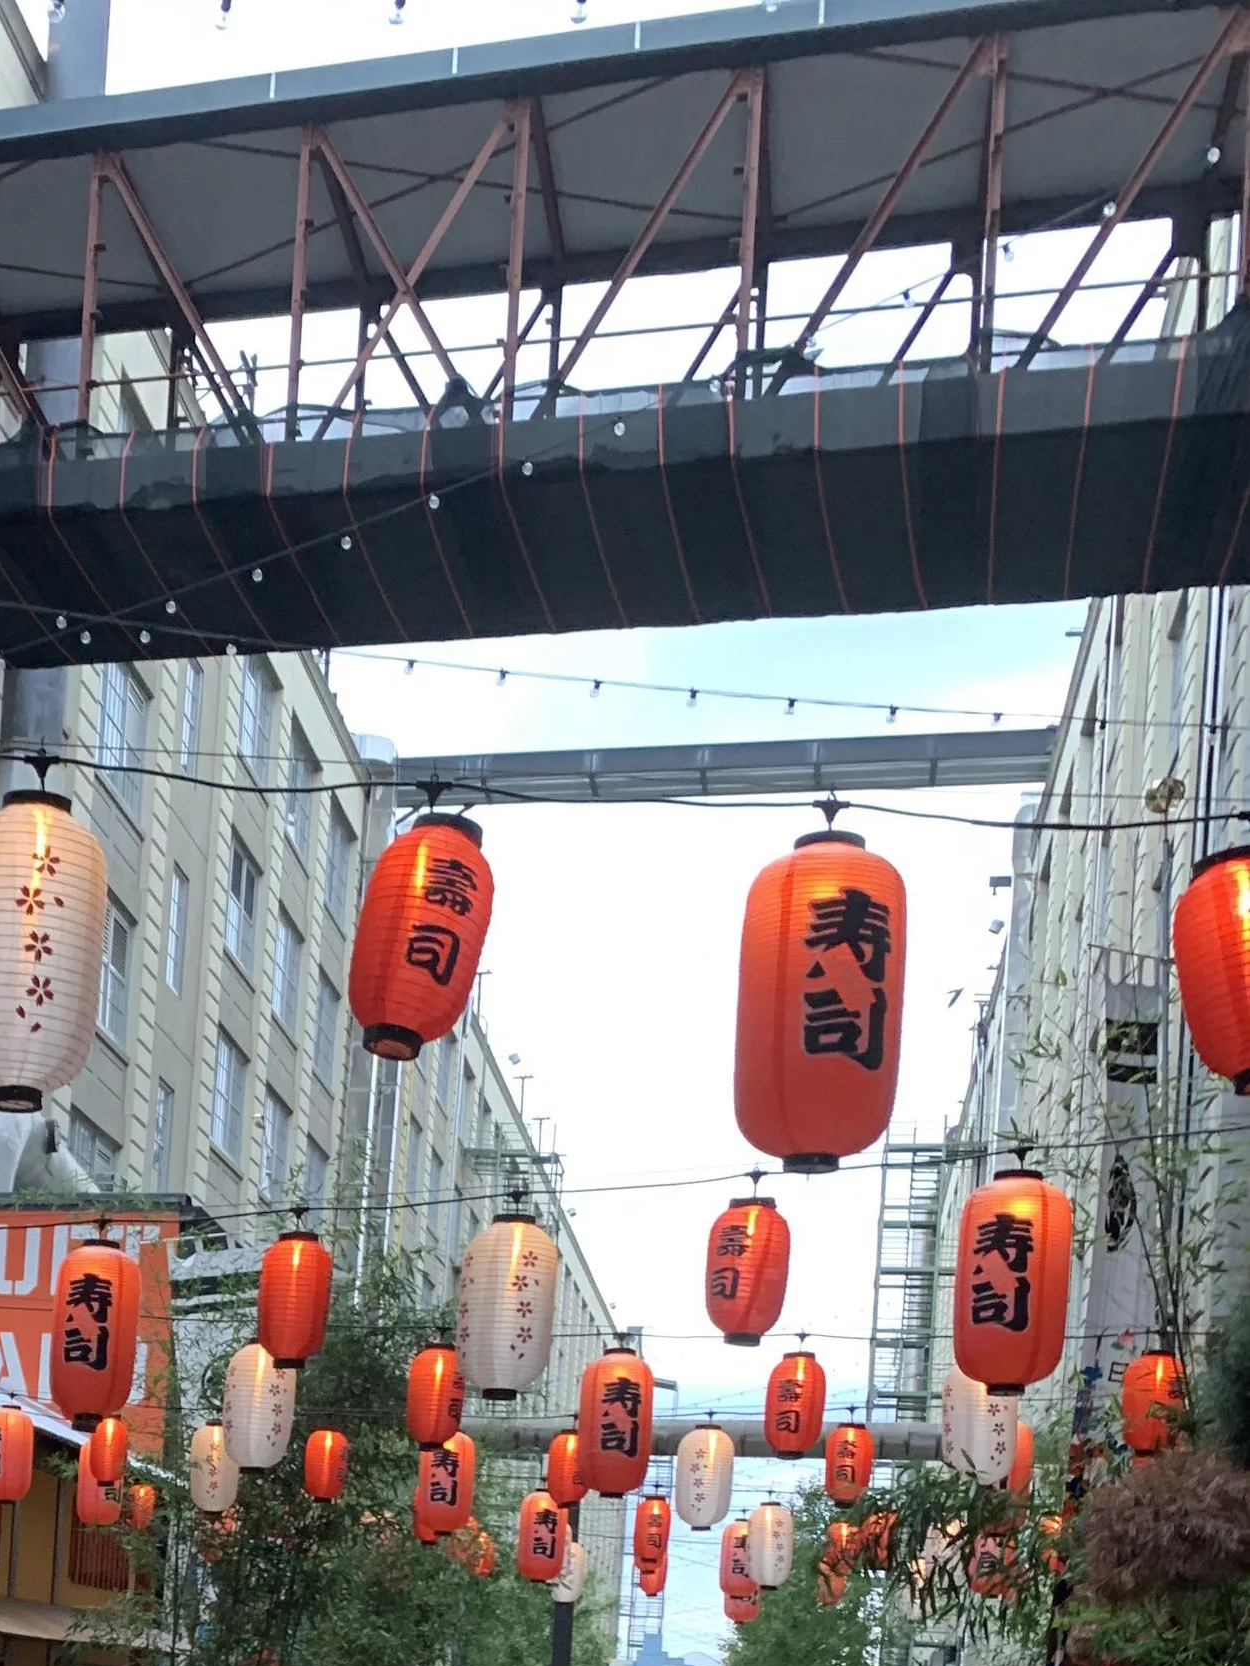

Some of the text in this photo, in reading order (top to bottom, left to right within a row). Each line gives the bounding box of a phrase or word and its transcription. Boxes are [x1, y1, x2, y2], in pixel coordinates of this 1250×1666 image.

[803, 889, 890, 1071] 寿司
[64, 1273, 113, 1370] 寿司
[971, 1213, 1034, 1331] 寿司
[601, 1377, 642, 1457] 寿司
